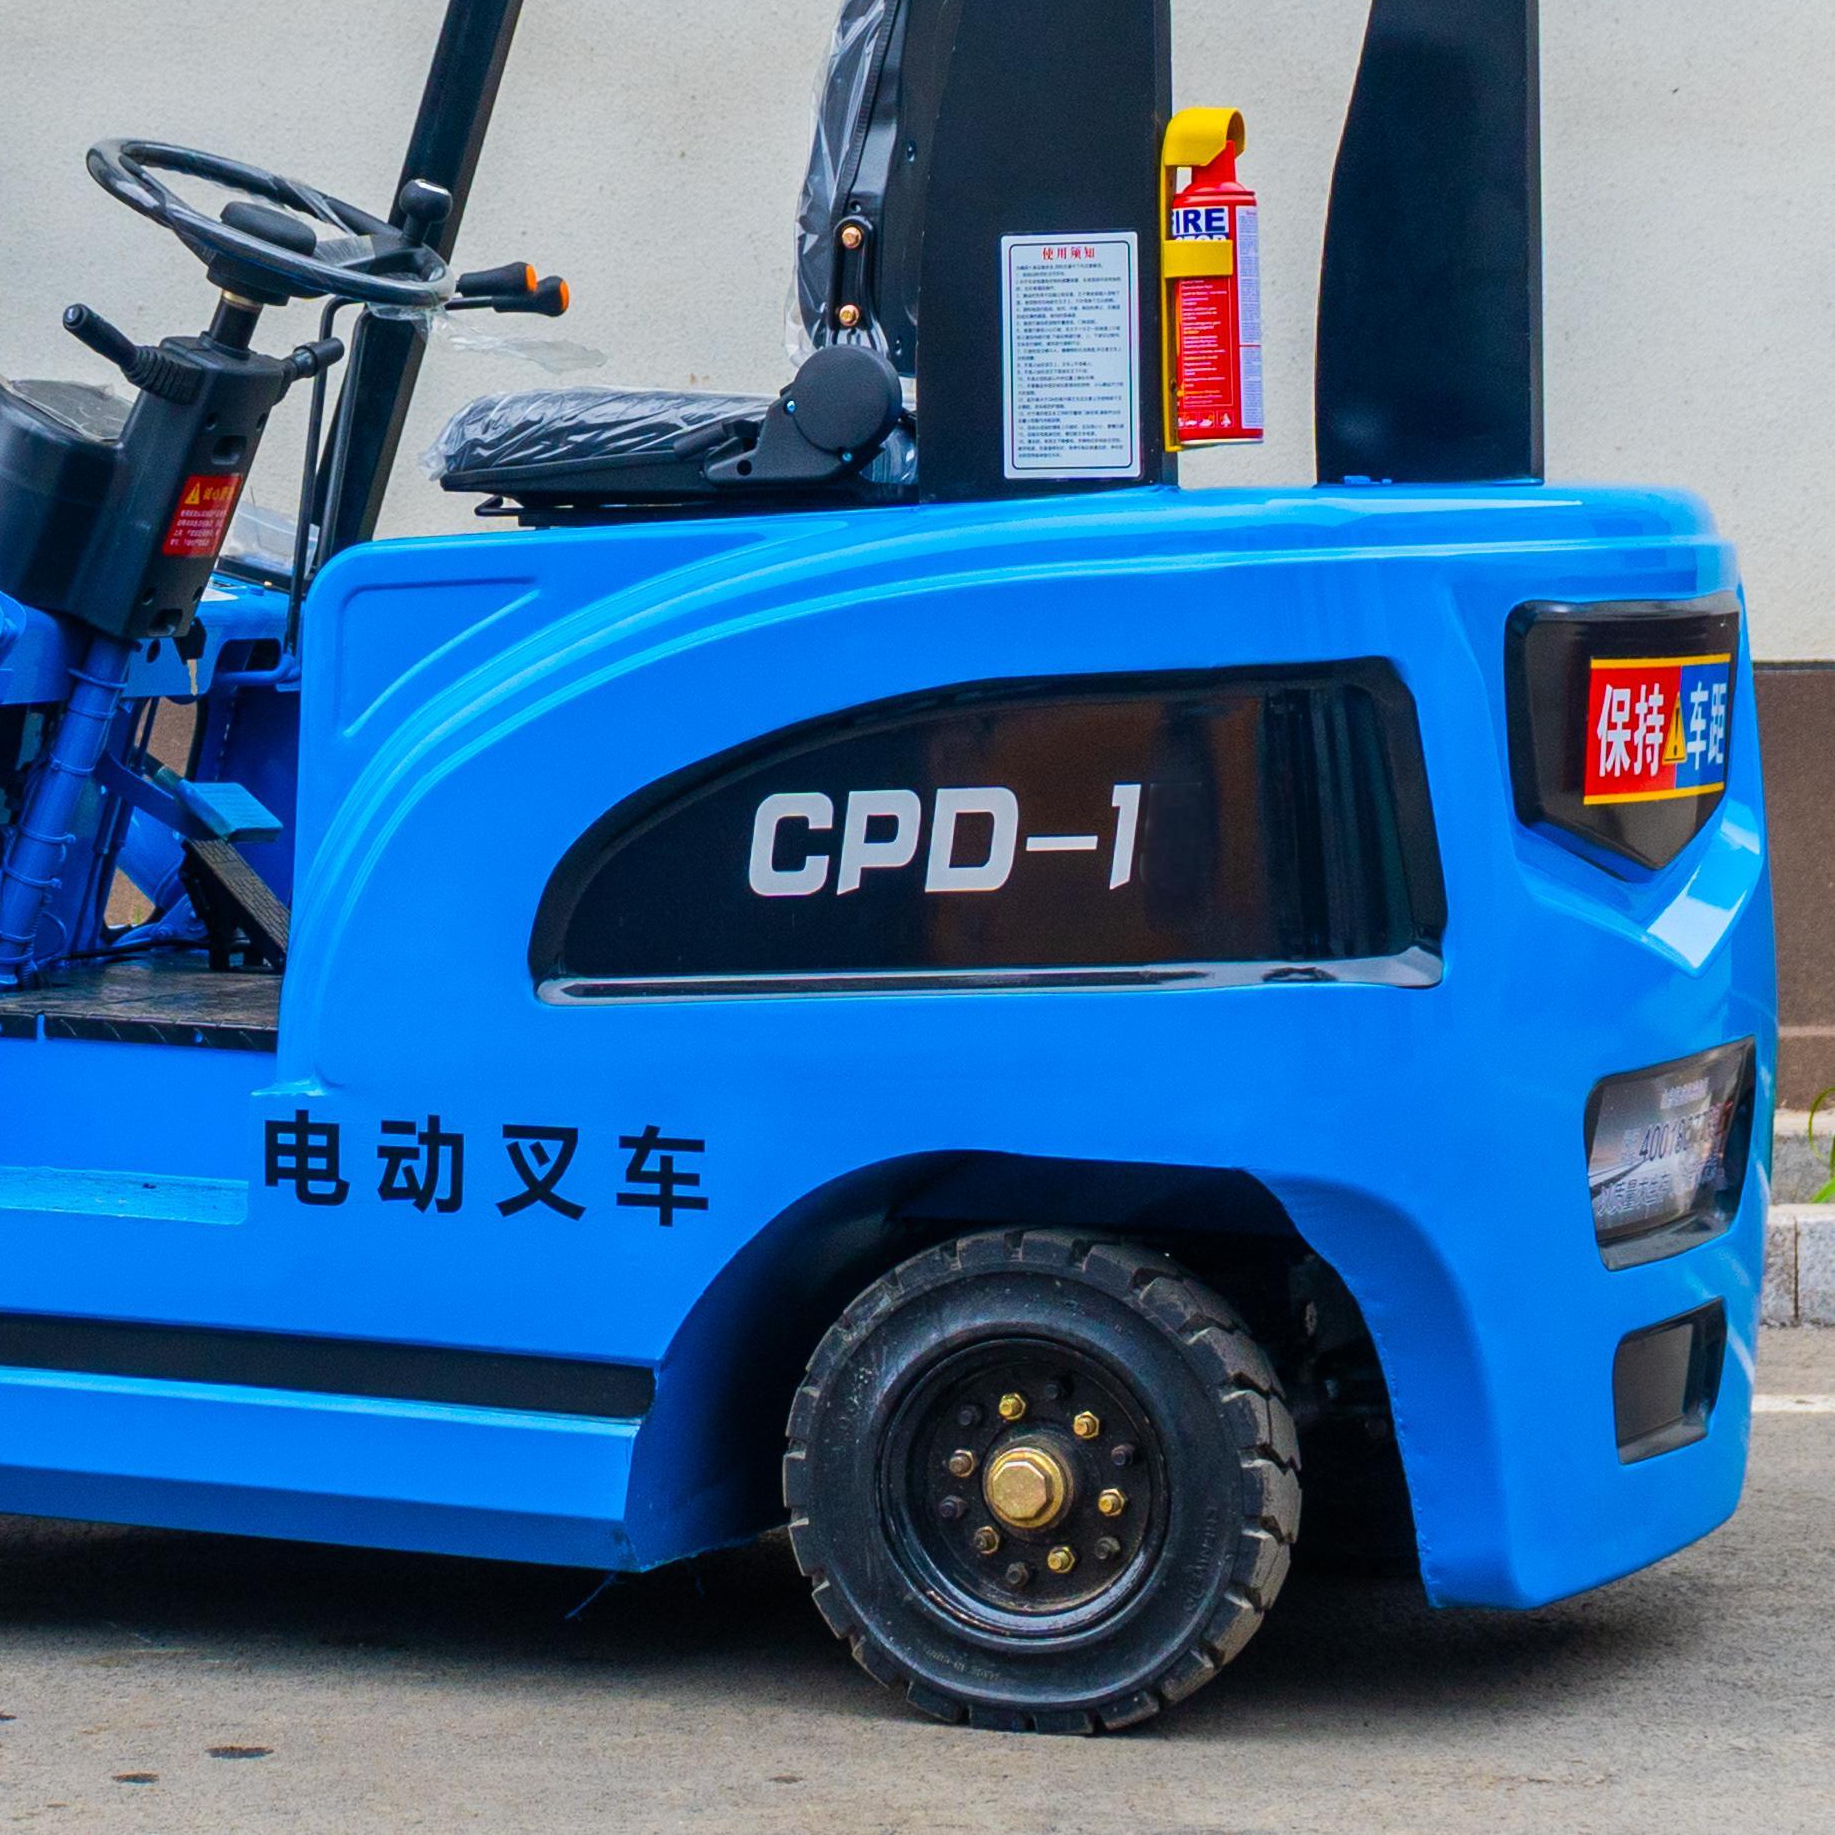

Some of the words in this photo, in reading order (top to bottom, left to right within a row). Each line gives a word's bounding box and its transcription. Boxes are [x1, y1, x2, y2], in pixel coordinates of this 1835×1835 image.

[1042, 246, 1095, 261] 使用须知
[1172, 208, 1226, 234] IRE
[1597, 683, 1665, 778] 保持
[1686, 681, 1727, 771] 车距
[748, 784, 1142, 897] CPD-1
[264, 1109, 709, 1228] 电动叉车
